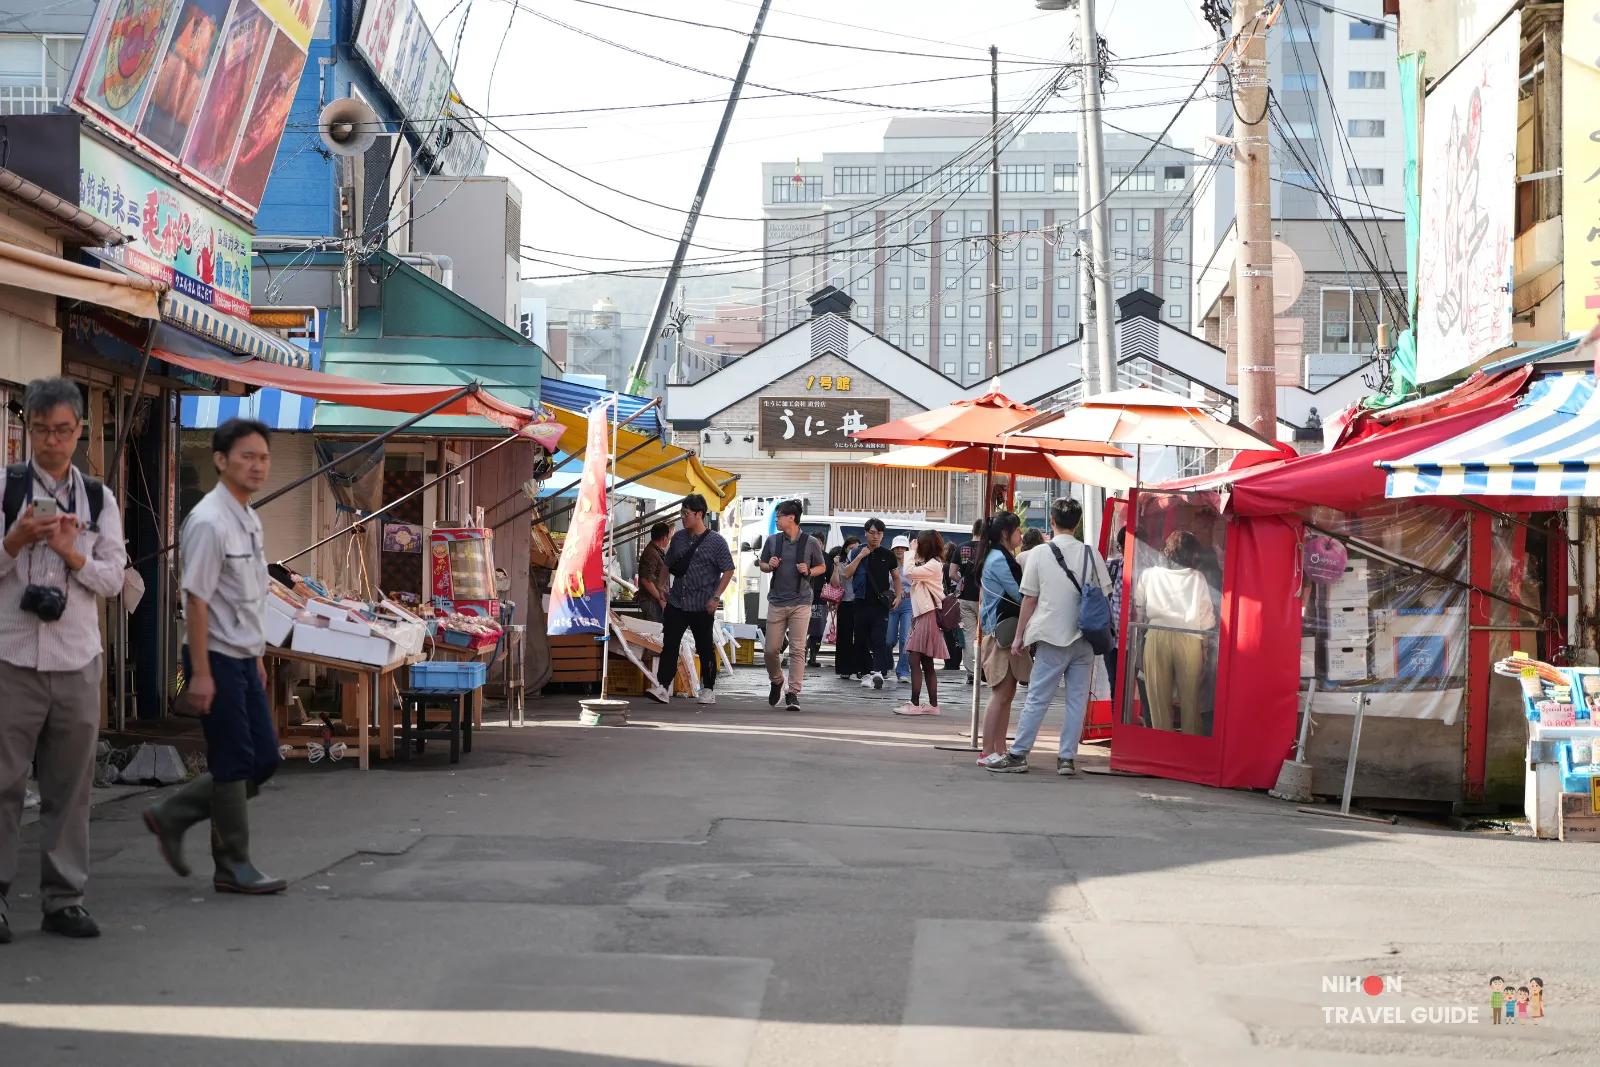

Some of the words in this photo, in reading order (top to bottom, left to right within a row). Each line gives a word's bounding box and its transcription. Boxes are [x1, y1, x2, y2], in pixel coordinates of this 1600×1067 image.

[128, 250, 151, 276] Welcome
[214, 291, 232, 311] Welcome
[1541, 704, 1562, 714] Special
